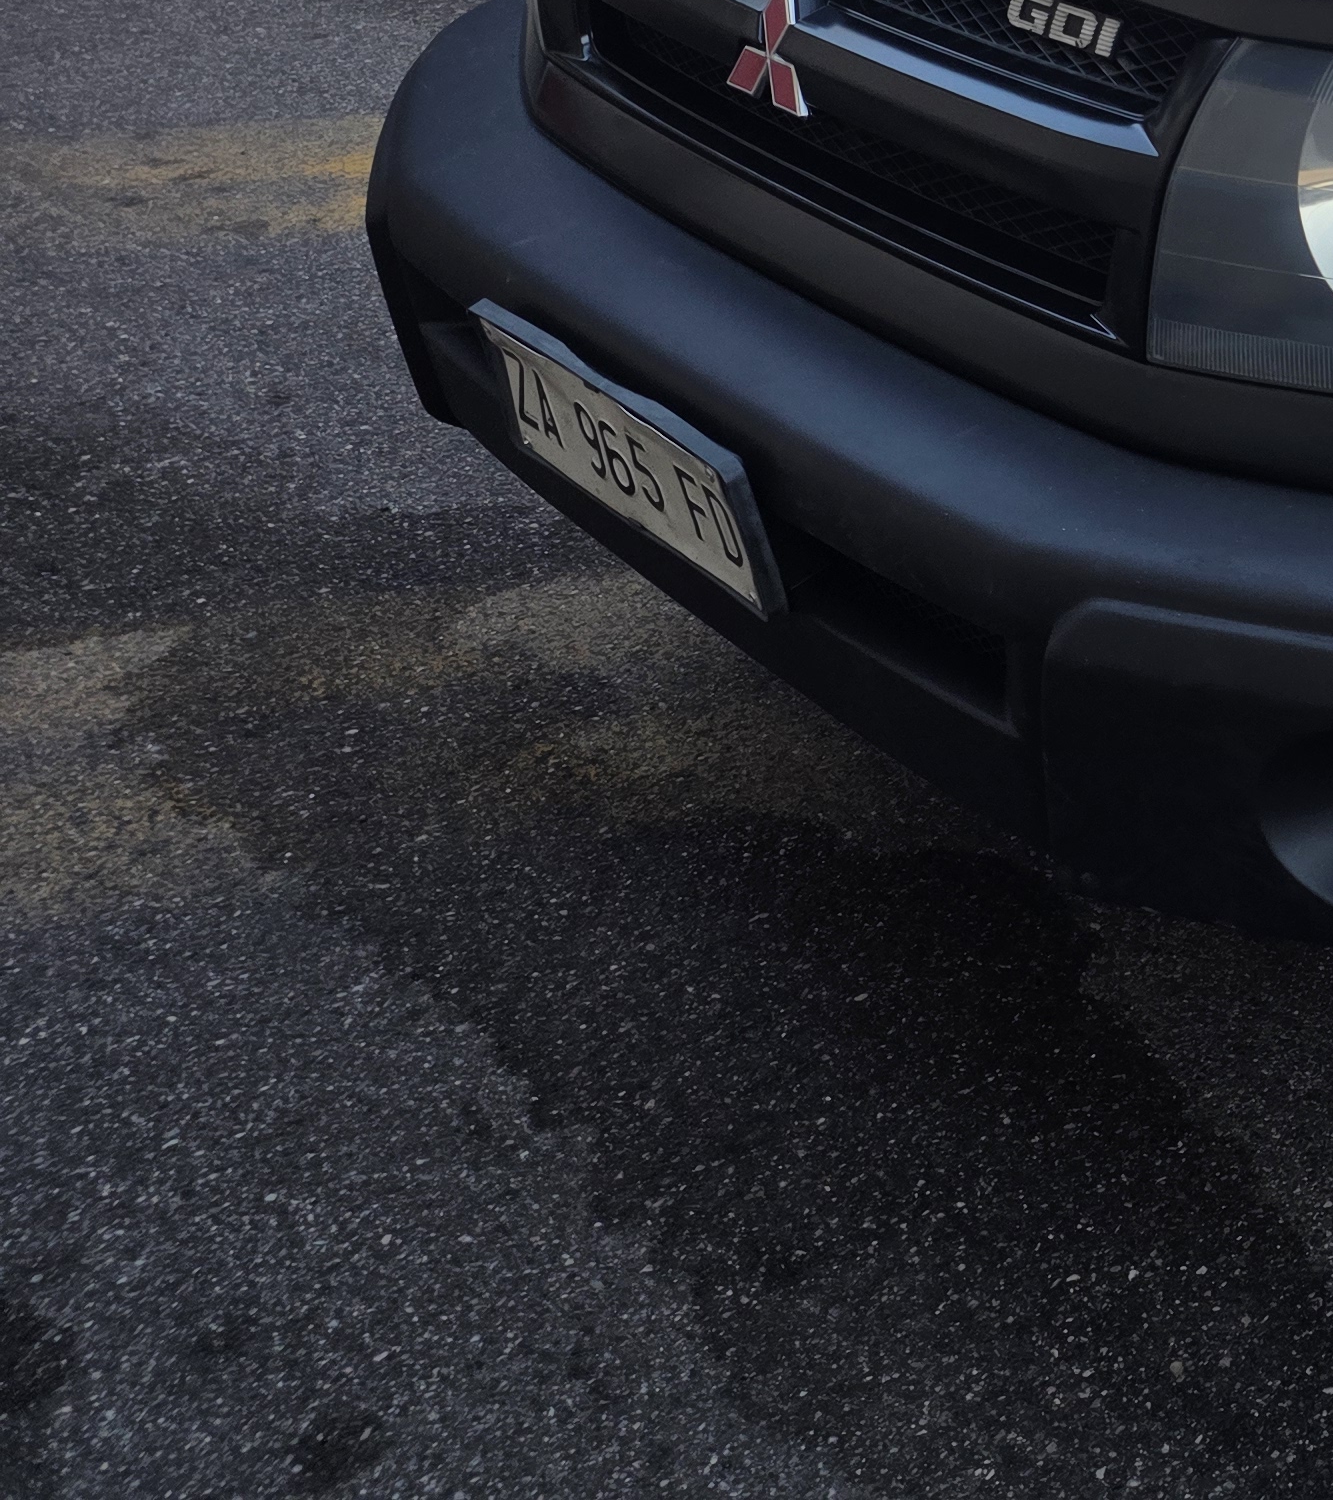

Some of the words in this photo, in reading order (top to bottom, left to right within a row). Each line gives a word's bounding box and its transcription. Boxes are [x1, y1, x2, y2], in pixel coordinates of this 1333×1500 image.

[502, 347, 565, 450] ZA
[573, 401, 665, 513] 965
[673, 464, 744, 568] FD
